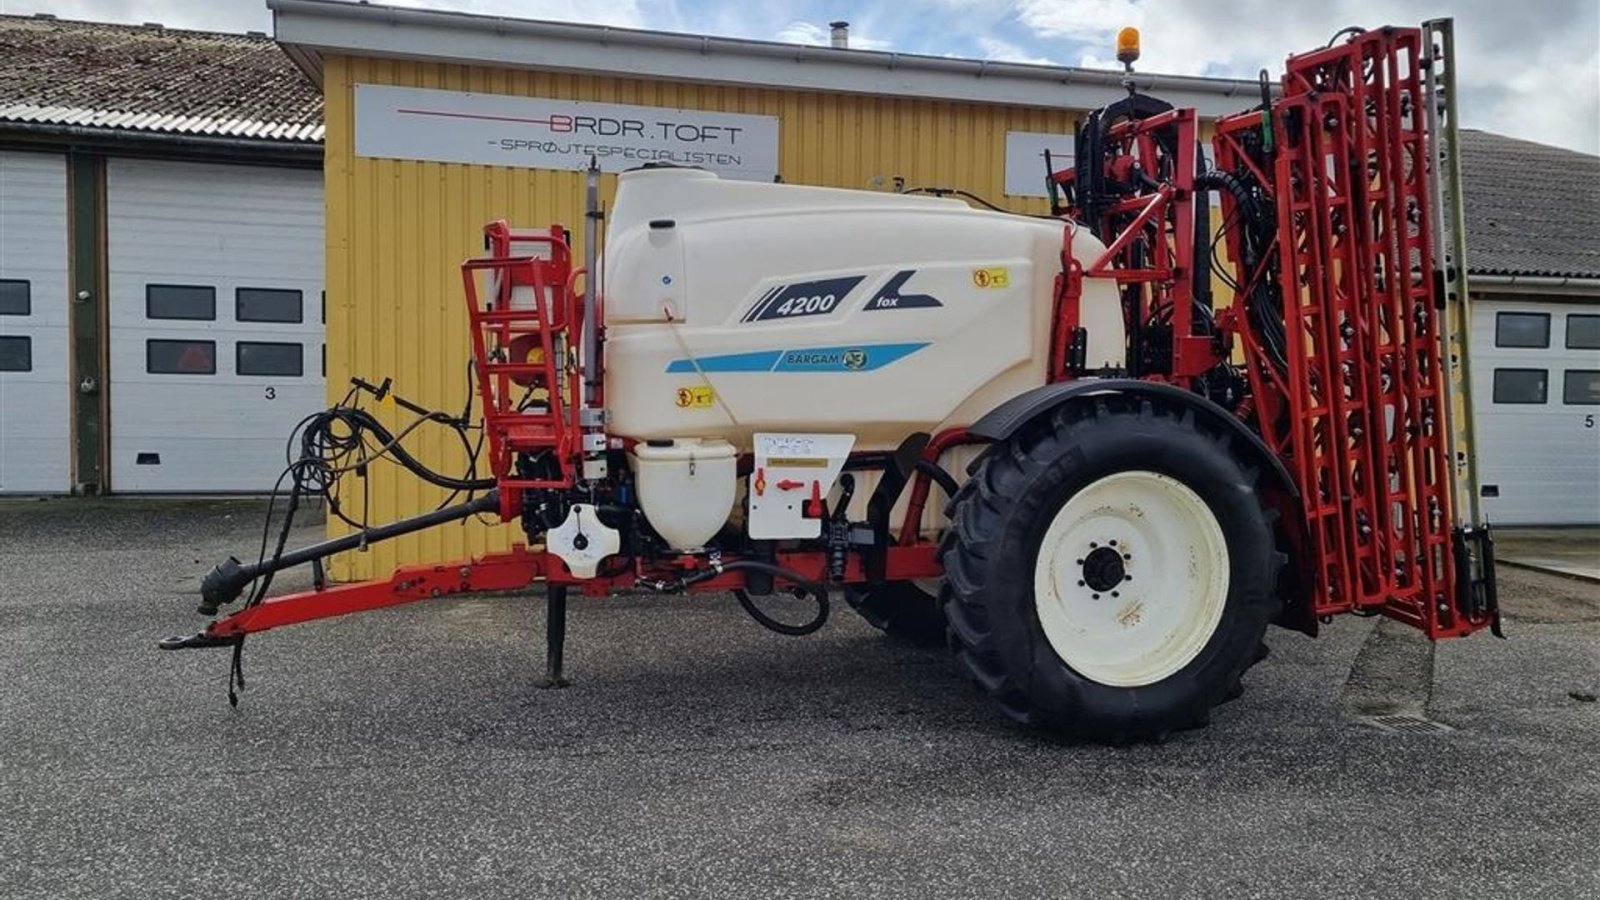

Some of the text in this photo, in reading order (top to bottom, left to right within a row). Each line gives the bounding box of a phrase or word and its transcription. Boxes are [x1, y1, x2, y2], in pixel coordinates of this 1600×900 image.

[777, 294, 836, 316] 4200
[876, 296, 899, 308] fox
[787, 354, 839, 364] BARGAM
[265, 387, 276, 400] 3
[1585, 414, 1594, 428] 5
